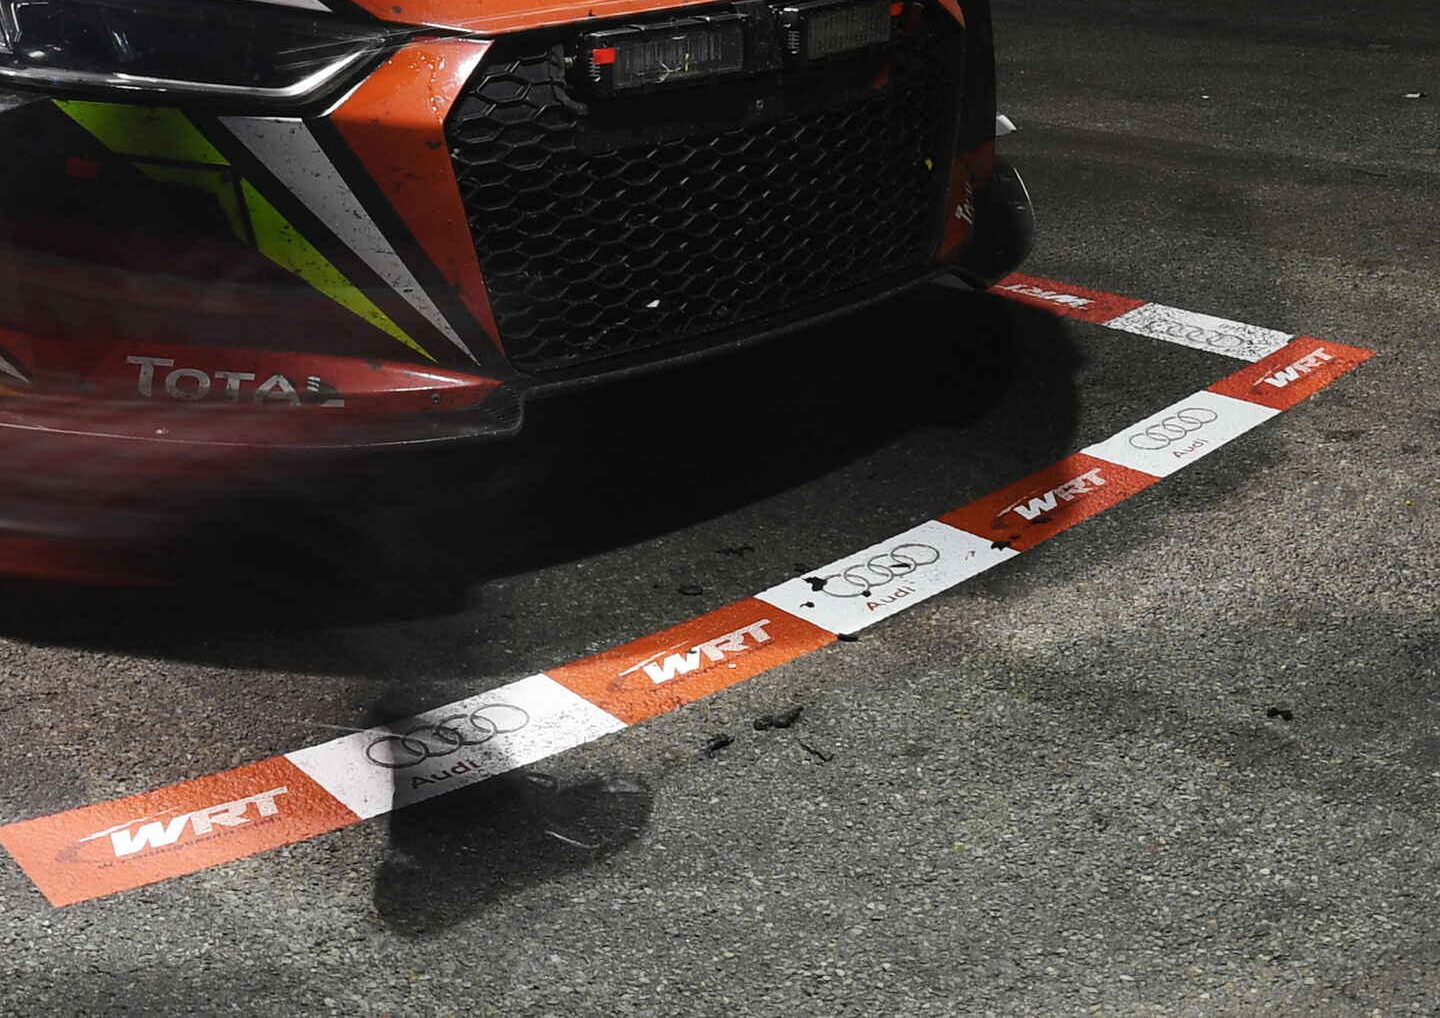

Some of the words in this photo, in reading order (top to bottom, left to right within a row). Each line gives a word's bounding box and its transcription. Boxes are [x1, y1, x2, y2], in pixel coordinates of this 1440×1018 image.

[126, 355, 346, 408] TOTAL
[1264, 346, 1336, 389] WRT
[1172, 438, 1209, 459] Audi
[1012, 466, 1107, 521] WRT
[864, 586, 916, 613] Audi
[642, 618, 772, 685] WRT
[410, 760, 481, 790] Audi
[109, 785, 289, 858] WRT
